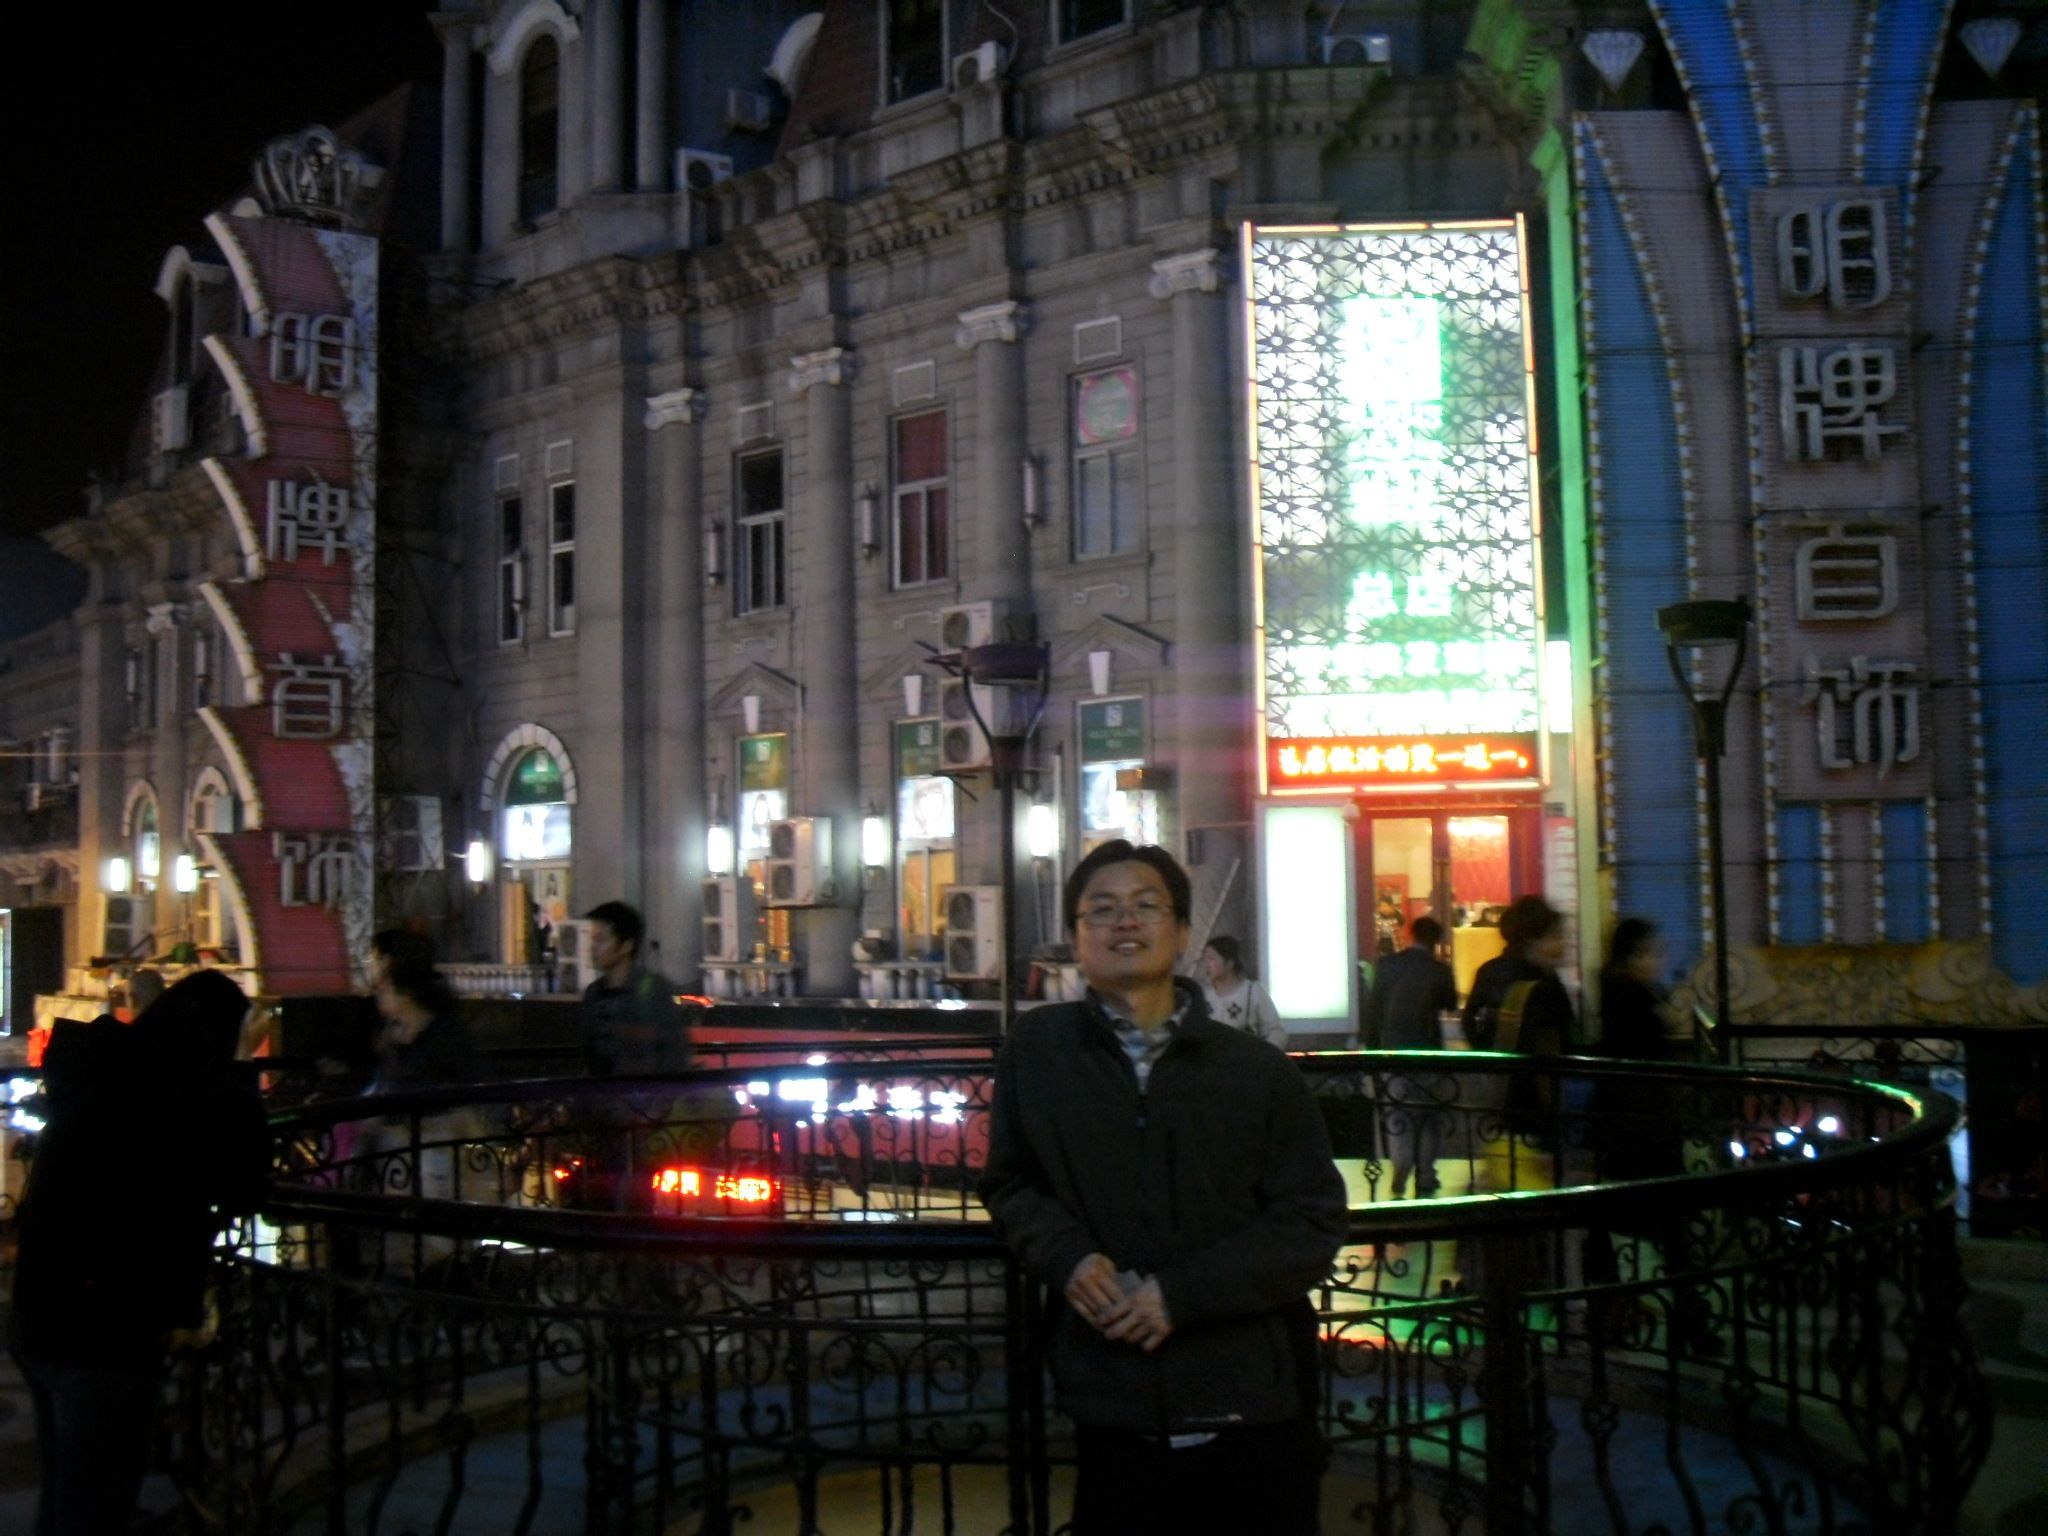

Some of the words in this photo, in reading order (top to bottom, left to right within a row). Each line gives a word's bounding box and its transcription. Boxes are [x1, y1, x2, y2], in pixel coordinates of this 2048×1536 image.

[266, 311, 356, 910] 明牌首饰
[1776, 199, 1919, 782] 明牌首饰
